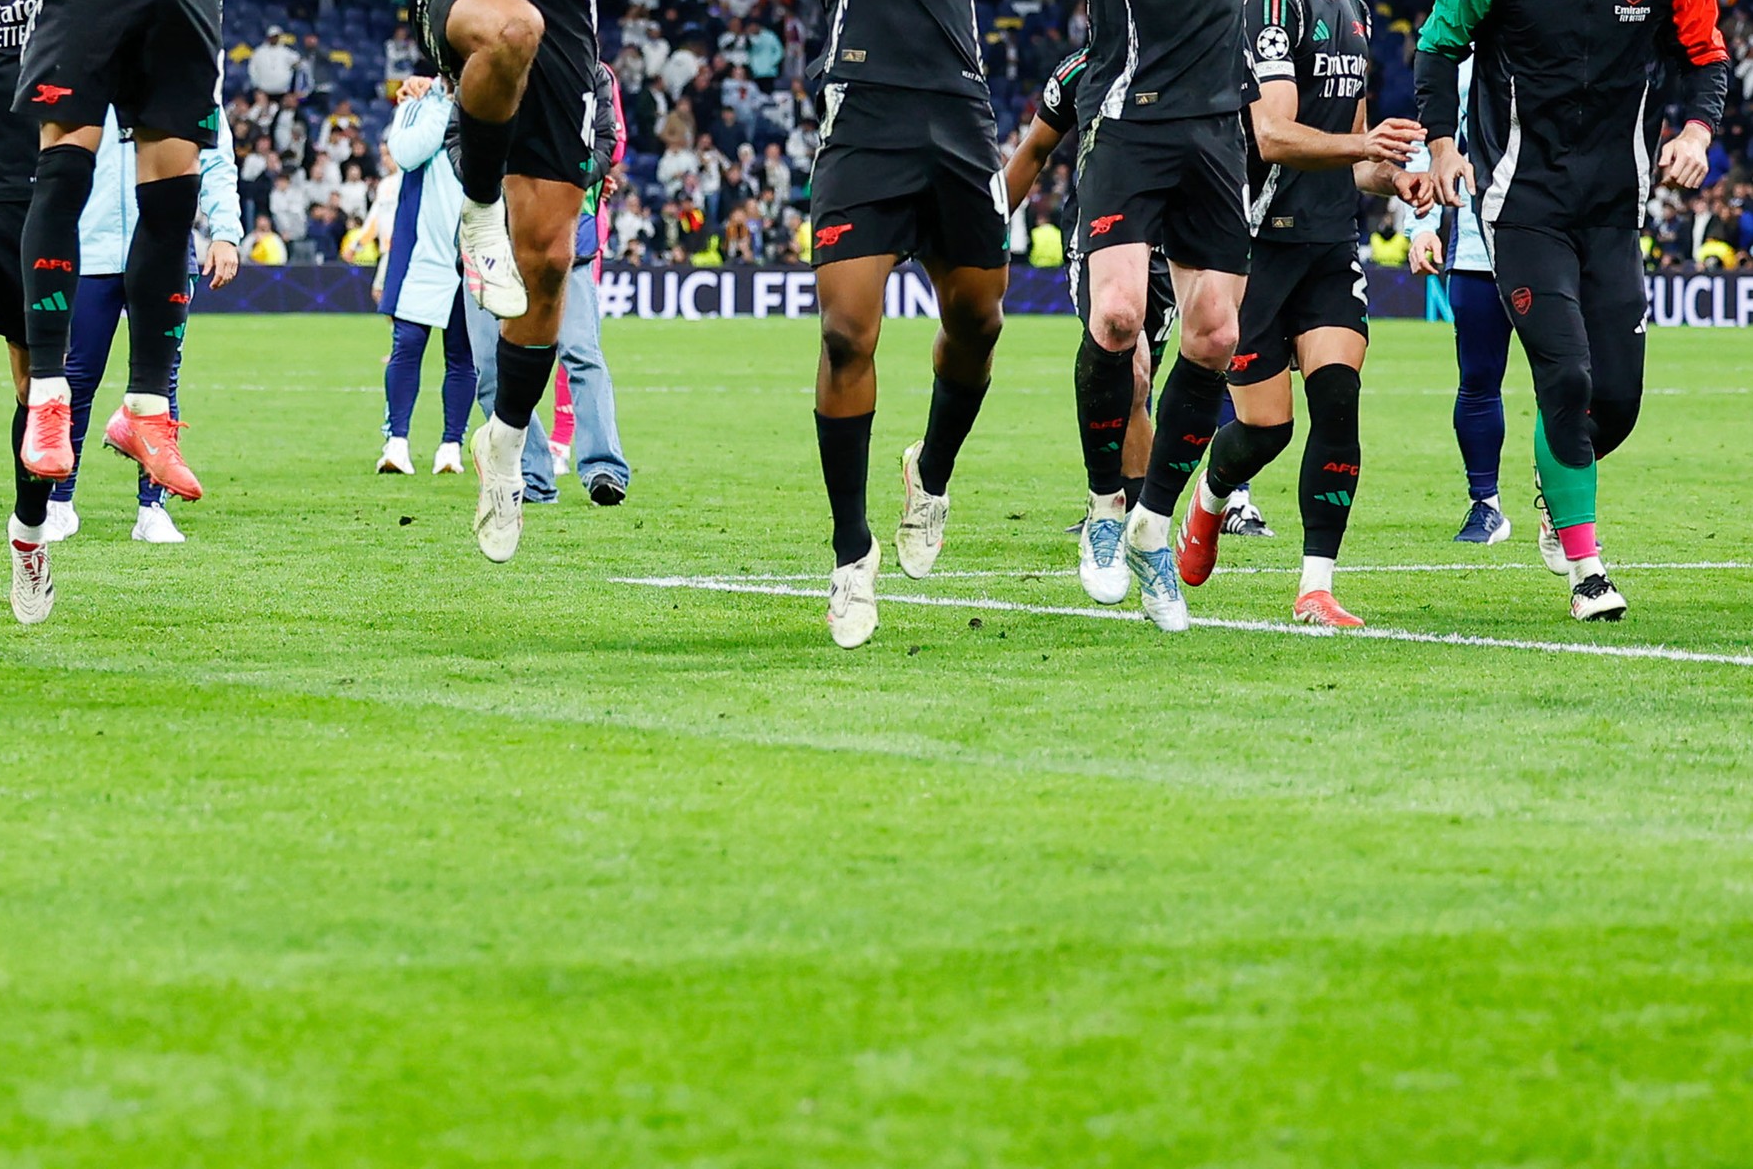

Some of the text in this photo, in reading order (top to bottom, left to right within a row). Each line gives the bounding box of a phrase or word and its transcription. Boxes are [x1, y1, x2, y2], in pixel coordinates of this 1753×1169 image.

[33, 257, 73, 272] AFC
[168, 292, 190, 305] AF
[1182, 433, 1211, 447] AF
[1322, 461, 1359, 477] AFC
